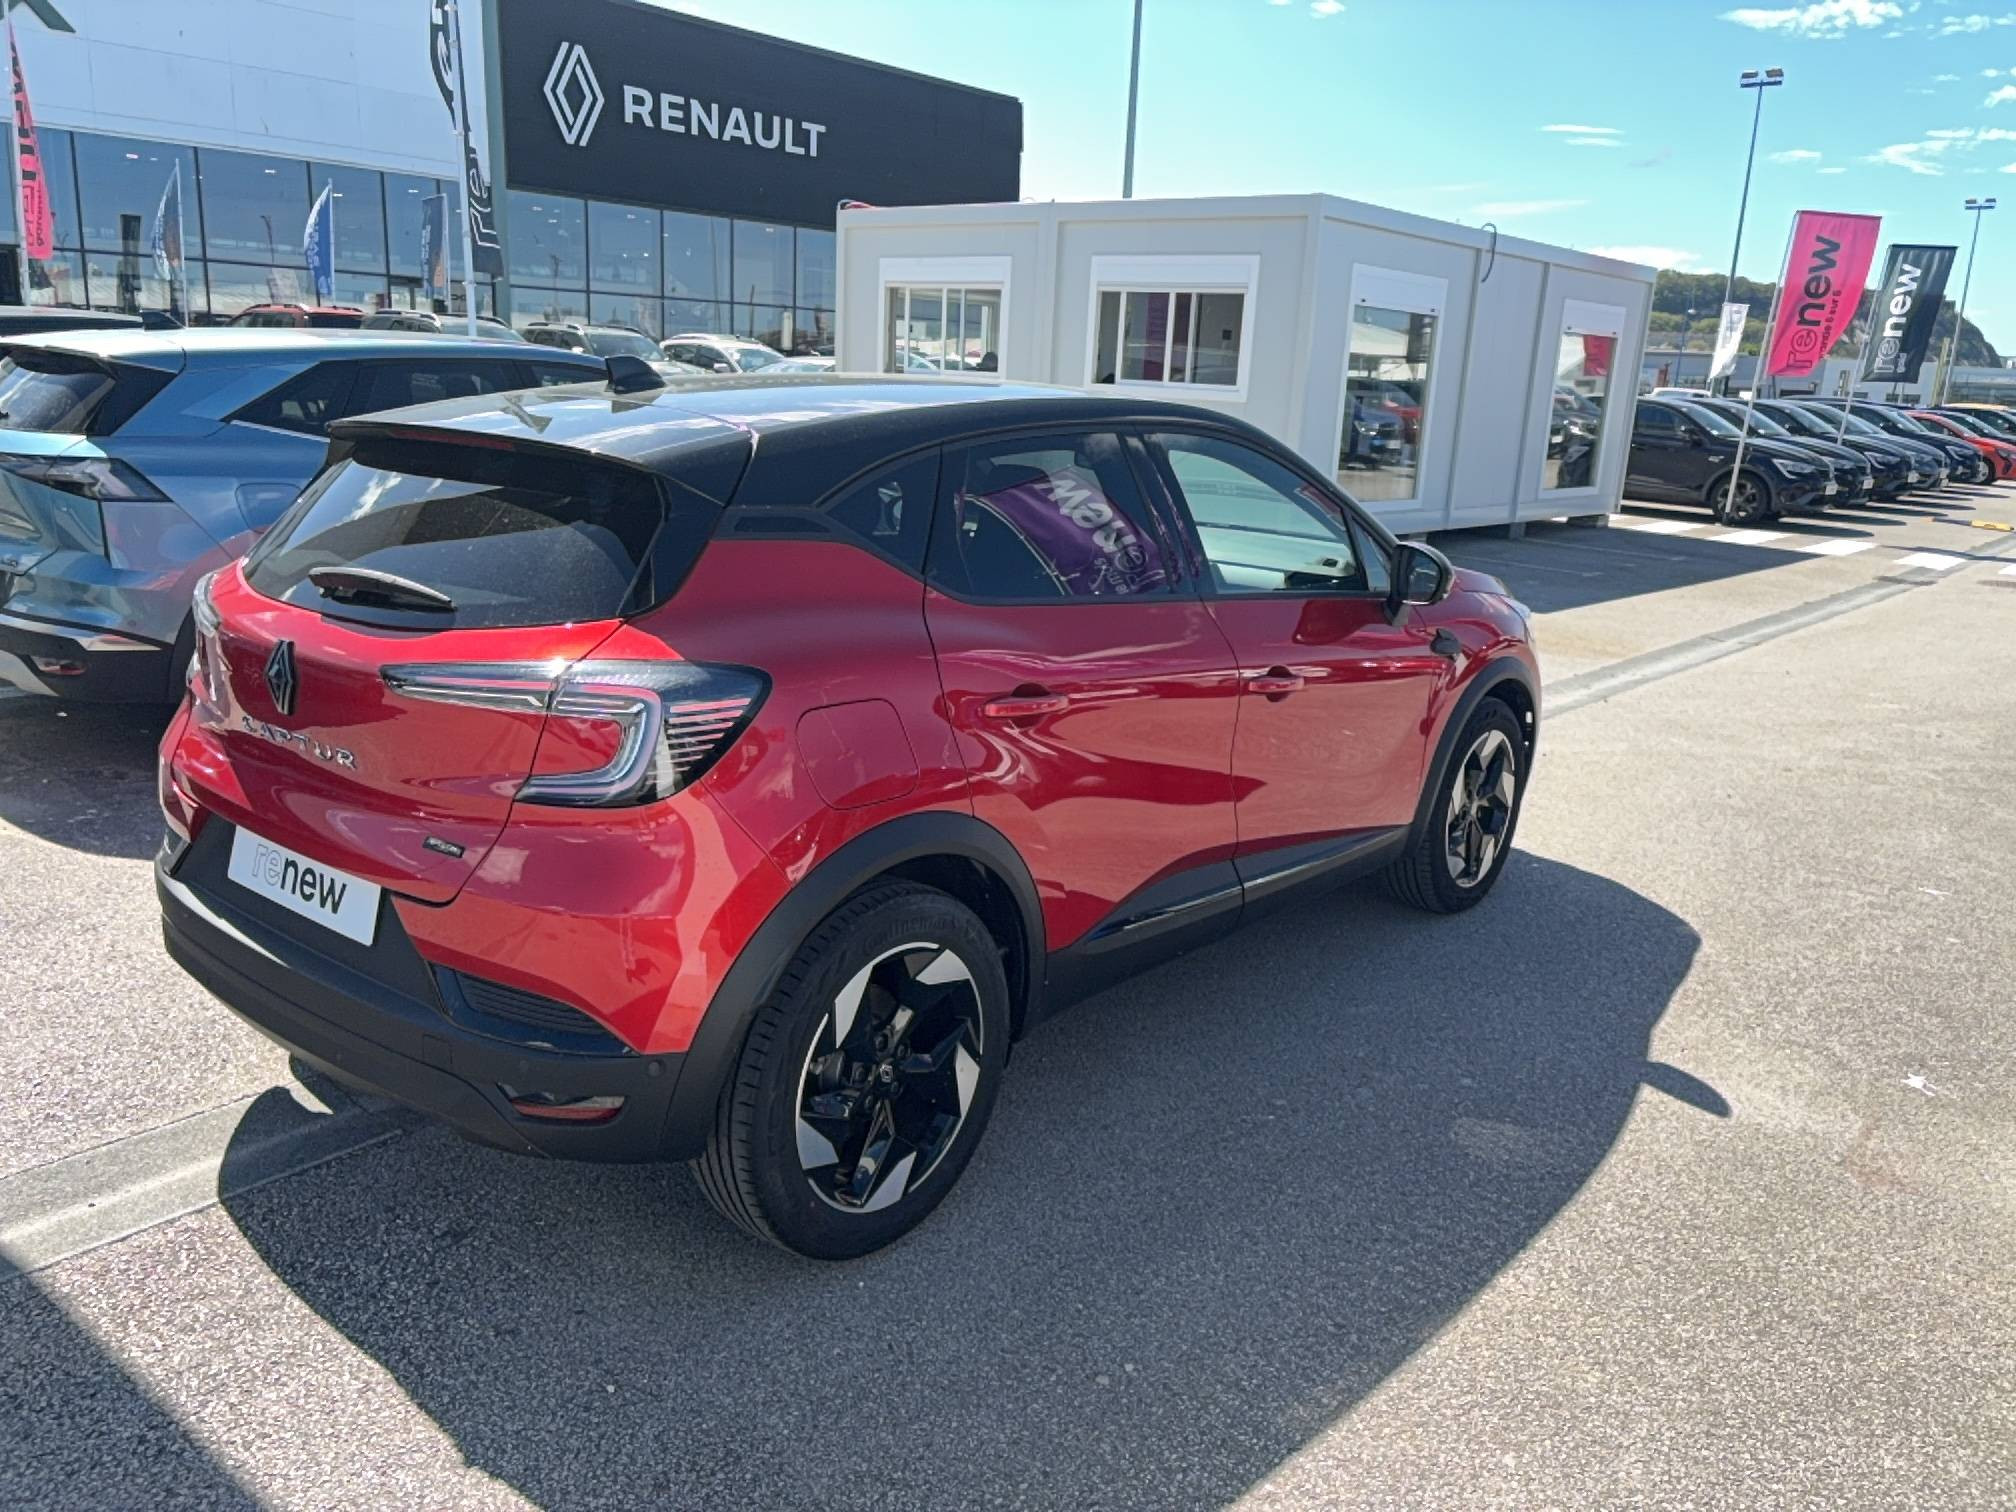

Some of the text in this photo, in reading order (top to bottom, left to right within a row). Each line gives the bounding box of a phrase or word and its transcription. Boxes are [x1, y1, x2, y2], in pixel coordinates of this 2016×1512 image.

[622, 84, 827, 157] RENAULT
[1786, 235, 1841, 369] renew
[1873, 262, 1922, 374] renew
[241, 715, 357, 771] CAPTUR
[251, 843, 347, 915] renew
